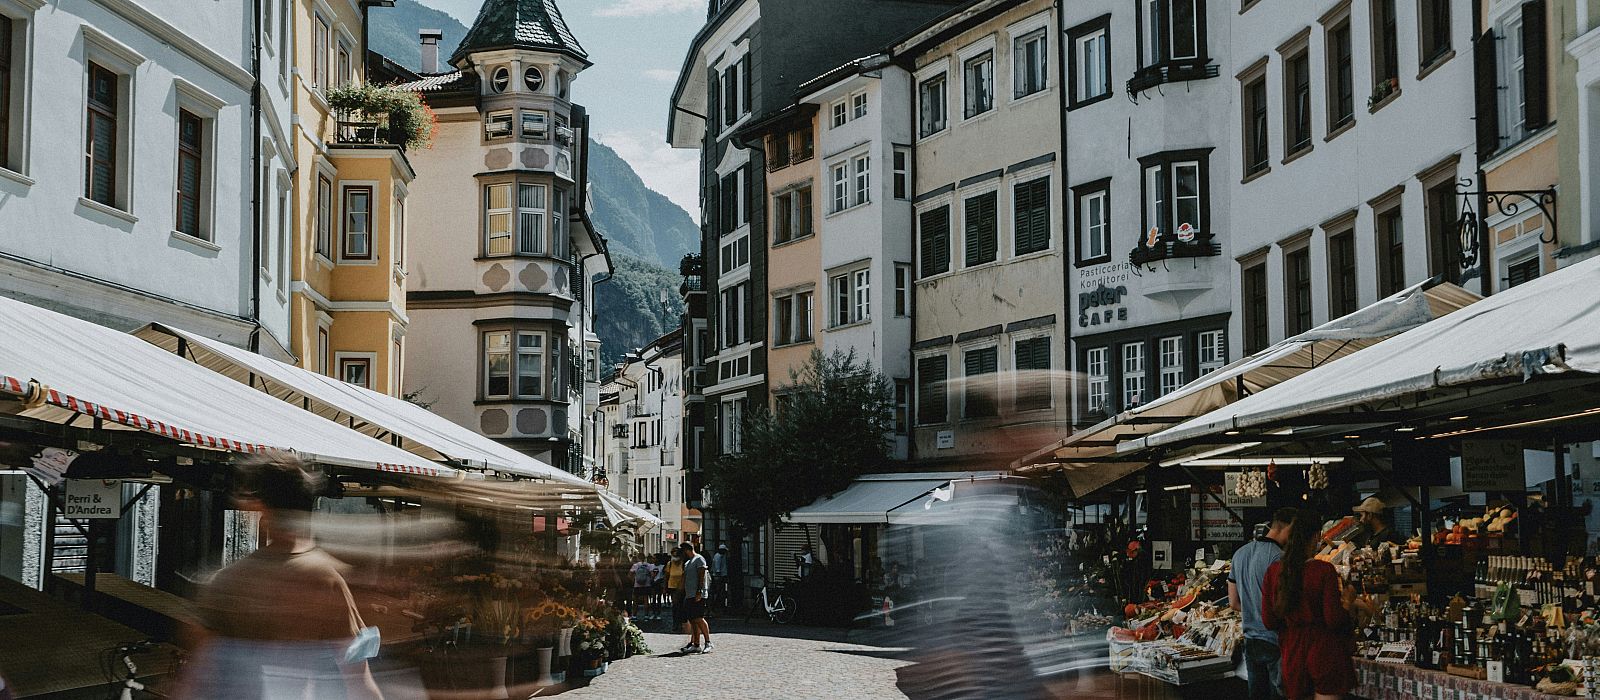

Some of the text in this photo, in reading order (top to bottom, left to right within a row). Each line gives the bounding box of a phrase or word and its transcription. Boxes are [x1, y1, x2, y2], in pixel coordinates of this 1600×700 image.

[1080, 260, 1129, 278] Pasticceria
[1080, 271, 1129, 289] Konditorei
[1078, 284, 1128, 316] peter
[1078, 307, 1128, 328] CAFE
[68, 493, 102, 504] Perri &
[67, 505, 112, 515] D'Andrea
